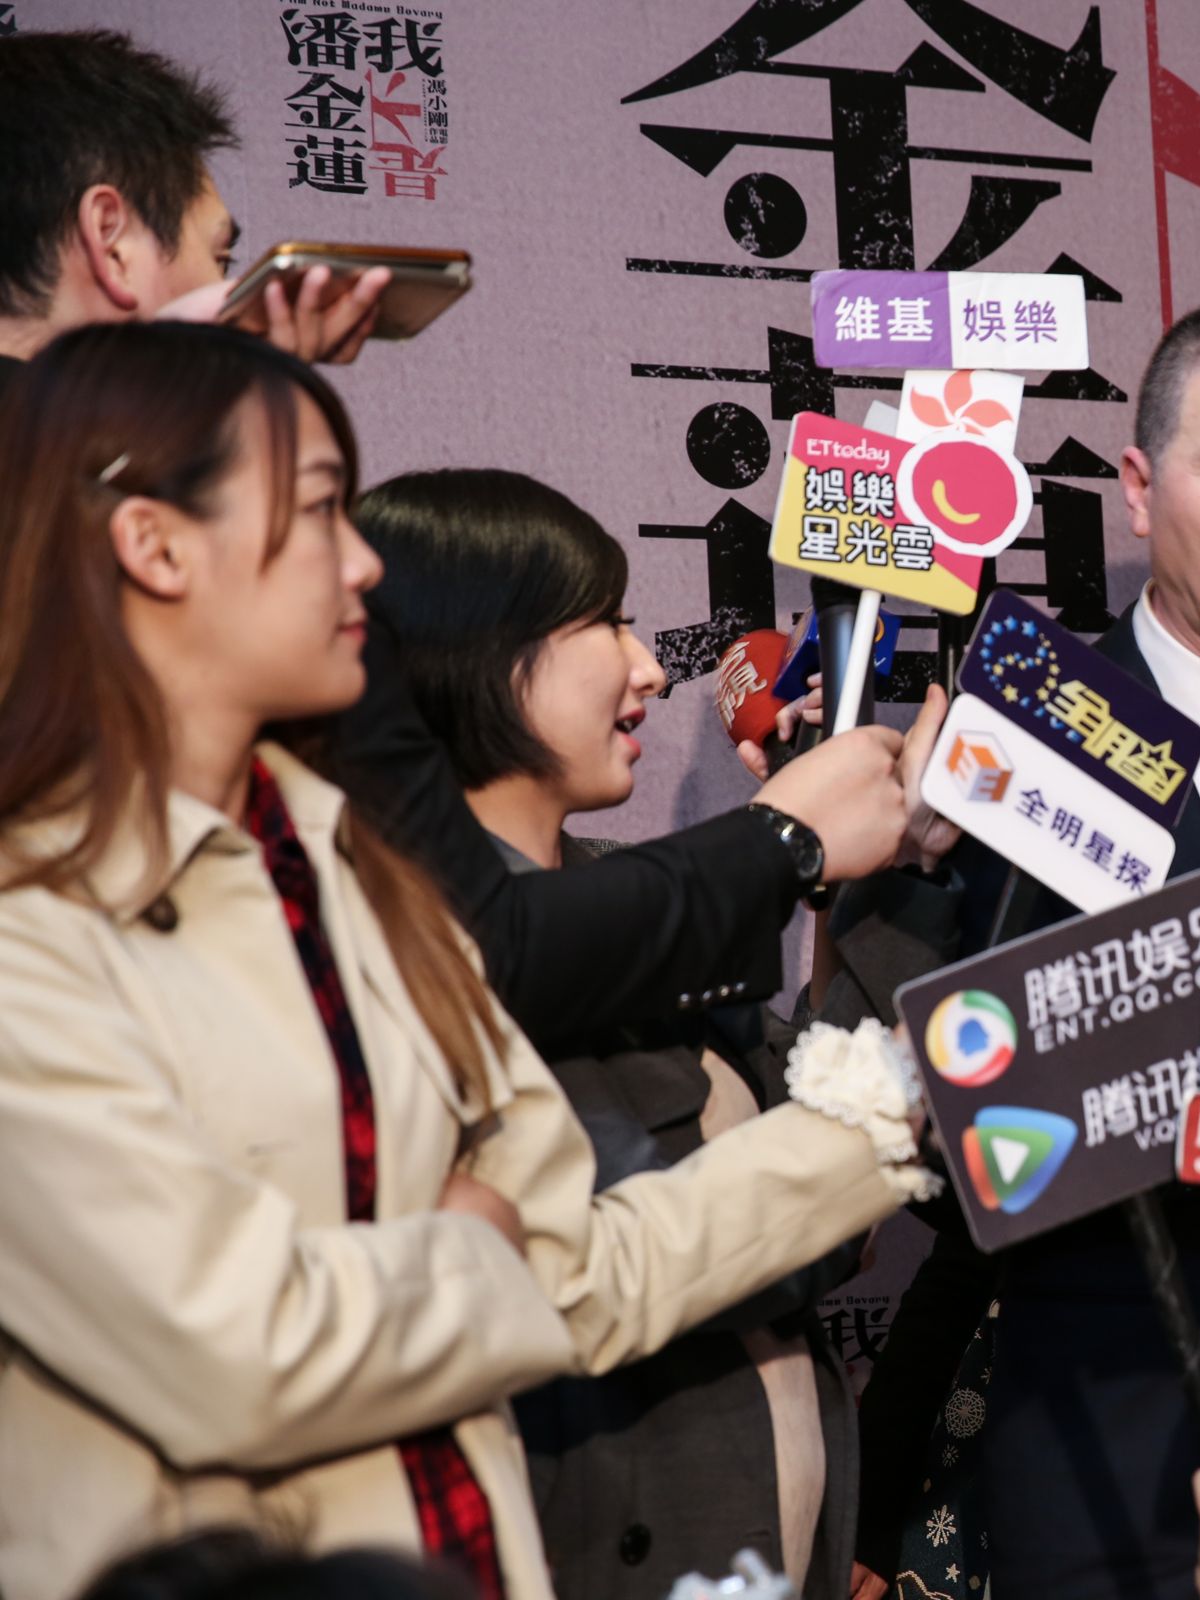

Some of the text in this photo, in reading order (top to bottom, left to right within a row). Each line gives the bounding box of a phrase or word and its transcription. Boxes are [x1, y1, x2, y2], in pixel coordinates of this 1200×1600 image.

[806, 438, 890, 470] ETtoday
[804, 466, 896, 519] 娛樂
[798, 515, 935, 571] 星光雲
